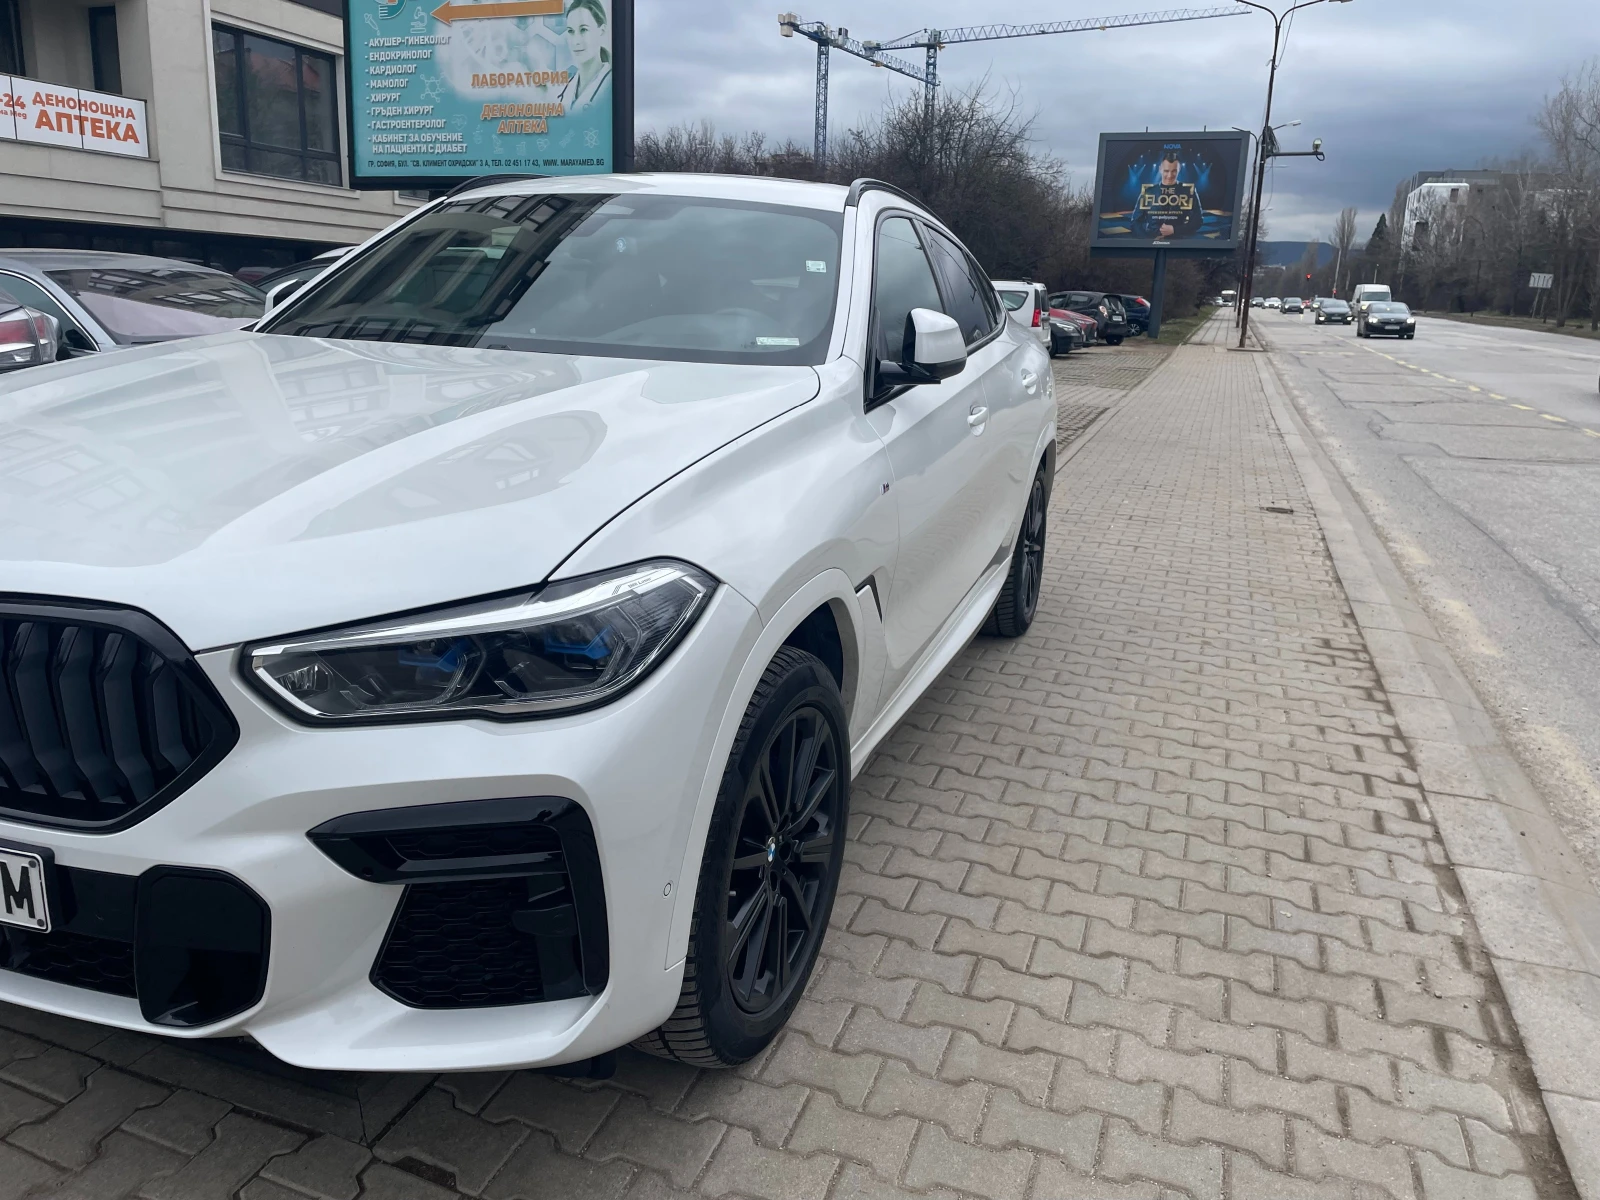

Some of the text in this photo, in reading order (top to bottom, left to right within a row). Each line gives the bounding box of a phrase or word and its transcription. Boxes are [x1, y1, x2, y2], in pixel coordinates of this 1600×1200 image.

[369, 36, 451, 47] АКУШЕР-ГИНЕКОЛОГ
[369, 50, 432, 61] ЕНДОКРИНОЛОГ
[369, 64, 417, 75] КАРДИОЛОГ
[370, 79, 408, 88] МАМОЛОГ
[471, 71, 569, 87] ЛАБОРАТОРИЯ
[370, 93, 401, 102] ХИРУРГ
[32, 91, 136, 120] ДЕНОНОЩНА
[371, 105, 434, 116] ГРЪДЕН ХИРУРГ
[481, 102, 564, 119] ДЕНОНОЩНА
[35, 109, 140, 144] АПТЕКА
[371, 119, 446, 129] ГАСТРОЕНТЕРОЛОГ
[497, 119, 547, 134] АПТЕКА
[372, 133, 463, 143] КАБИНЕТ ЗА ОБУЧЕНИЕ
[372, 144, 384, 153] НА
[384, 144, 427, 154] ПАЦИЕНТИ
[435, 144, 467, 154] ДИАБЕТ
[1145, 195, 1188, 206] FLOOR
[0, 861, 35, 919] M
